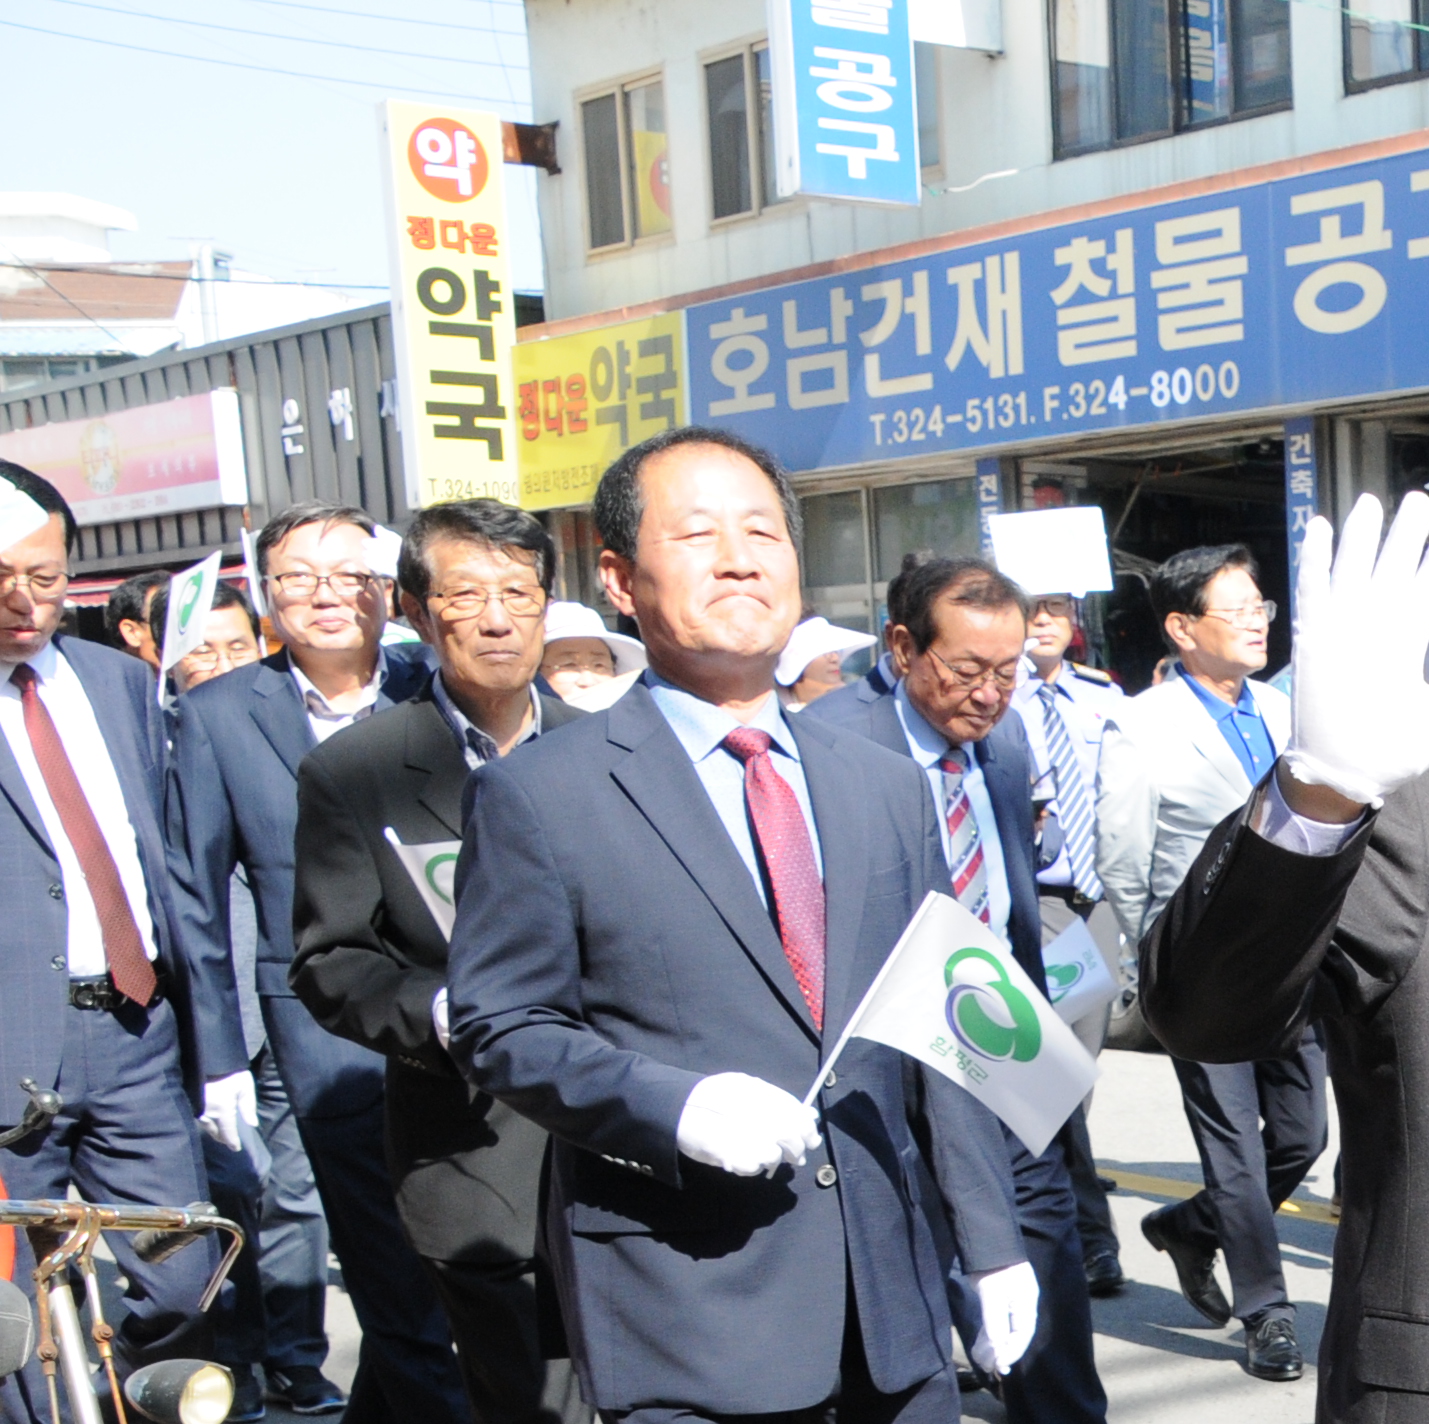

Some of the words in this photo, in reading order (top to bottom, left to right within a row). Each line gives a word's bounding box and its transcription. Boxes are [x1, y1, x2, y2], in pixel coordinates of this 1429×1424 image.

[416, 127, 477, 196] 약
[809, 46, 900, 180] 공구
[407, 215, 498, 256] 정다운
[416, 266, 507, 461] 약국
[708, 250, 1025, 417] 호남건재
[1050, 206, 1249, 367] 철물
[518, 373, 588, 441] 정다운
[590, 333, 678, 447] 약국
[1043, 359, 1241, 423] F.324-8000
